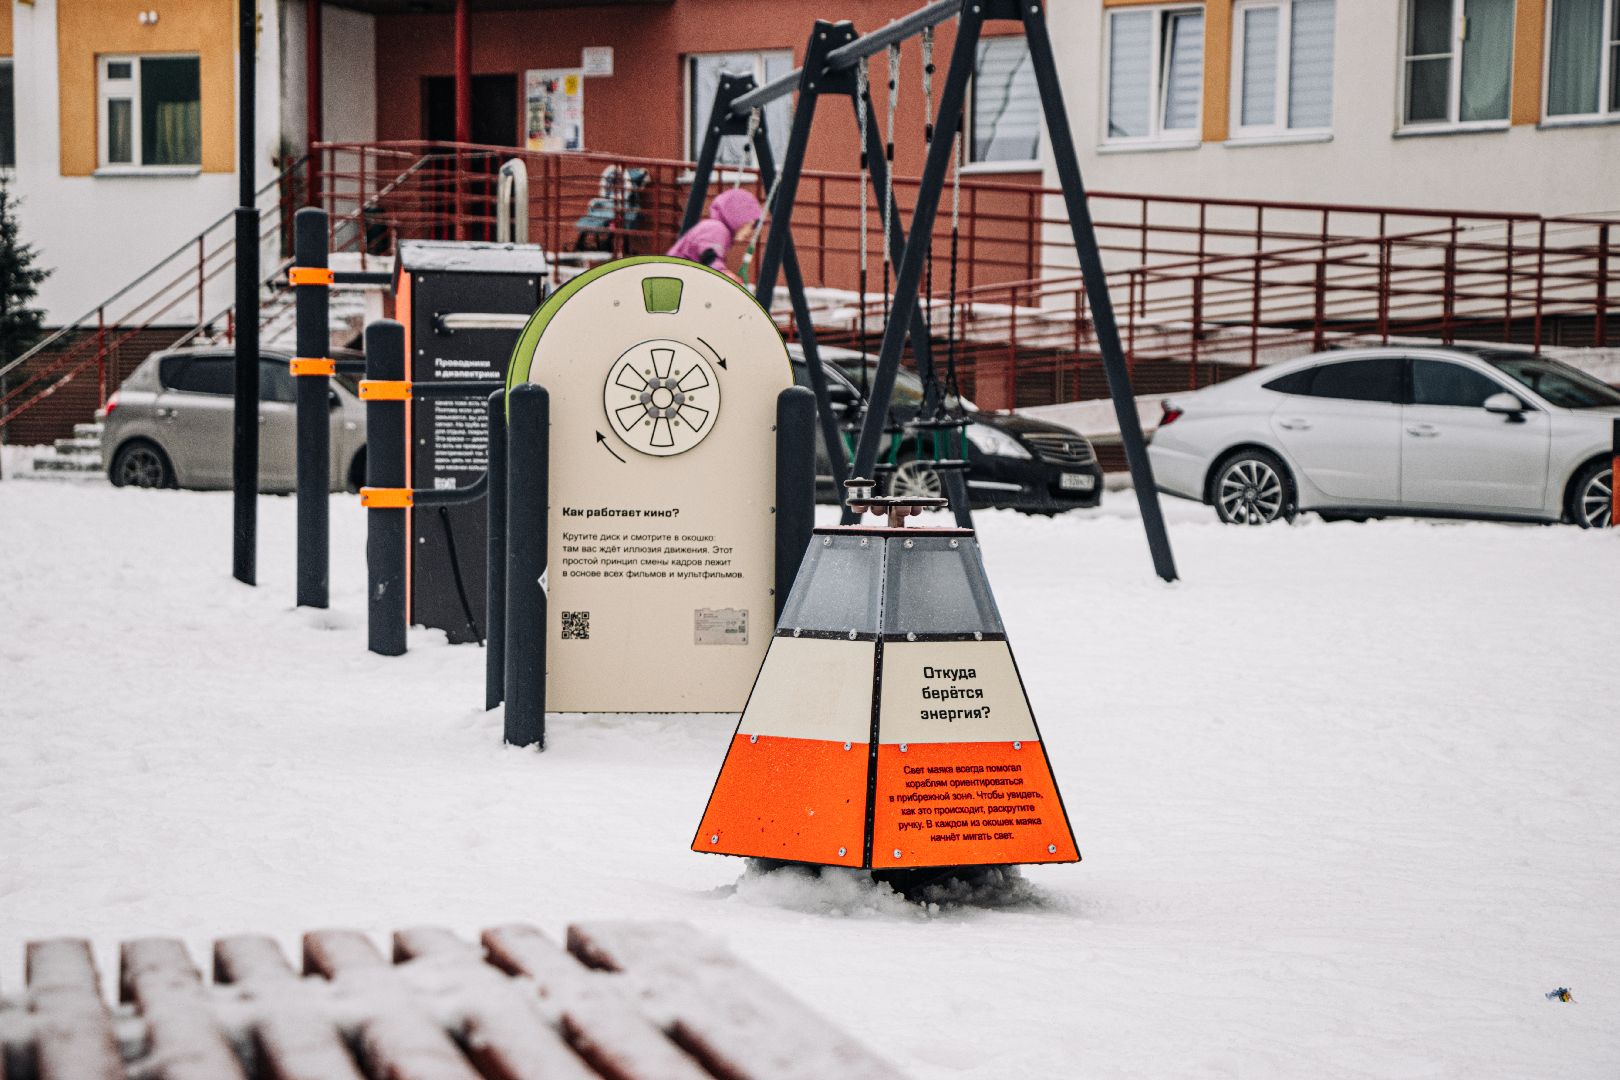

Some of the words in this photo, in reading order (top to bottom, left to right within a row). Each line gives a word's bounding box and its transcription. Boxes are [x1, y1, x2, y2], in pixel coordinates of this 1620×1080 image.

[563, 507, 583, 516] Как
[587, 507, 641, 518] работает
[644, 509, 679, 517] кино?
[563, 532, 597, 542] Крутите
[563, 557, 598, 566] простой
[626, 570, 666, 578] фильмов
[677, 571, 744, 579] мультфильмов.
[924, 667, 976, 681] Откуда
[922, 686, 983, 701] берётся
[921, 706, 990, 722] энергия?
[904, 766, 924, 774] Свет
[955, 766, 984, 774] всегда
[906, 779, 947, 789] кораблям
[950, 778, 1023, 788] ориентироваться
[897, 792, 950, 803] прибрежной
[976, 790, 1004, 799] Чтобы
[1007, 792, 1043, 800] увидеть,
[934, 806, 985, 816] происходит,
[988, 805, 1035, 814] раскрутите
[898, 822, 924, 831] ручку.
[926, 820, 933, 828] В
[935, 820, 968, 829] каждом
[931, 833, 960, 841] начнёт
